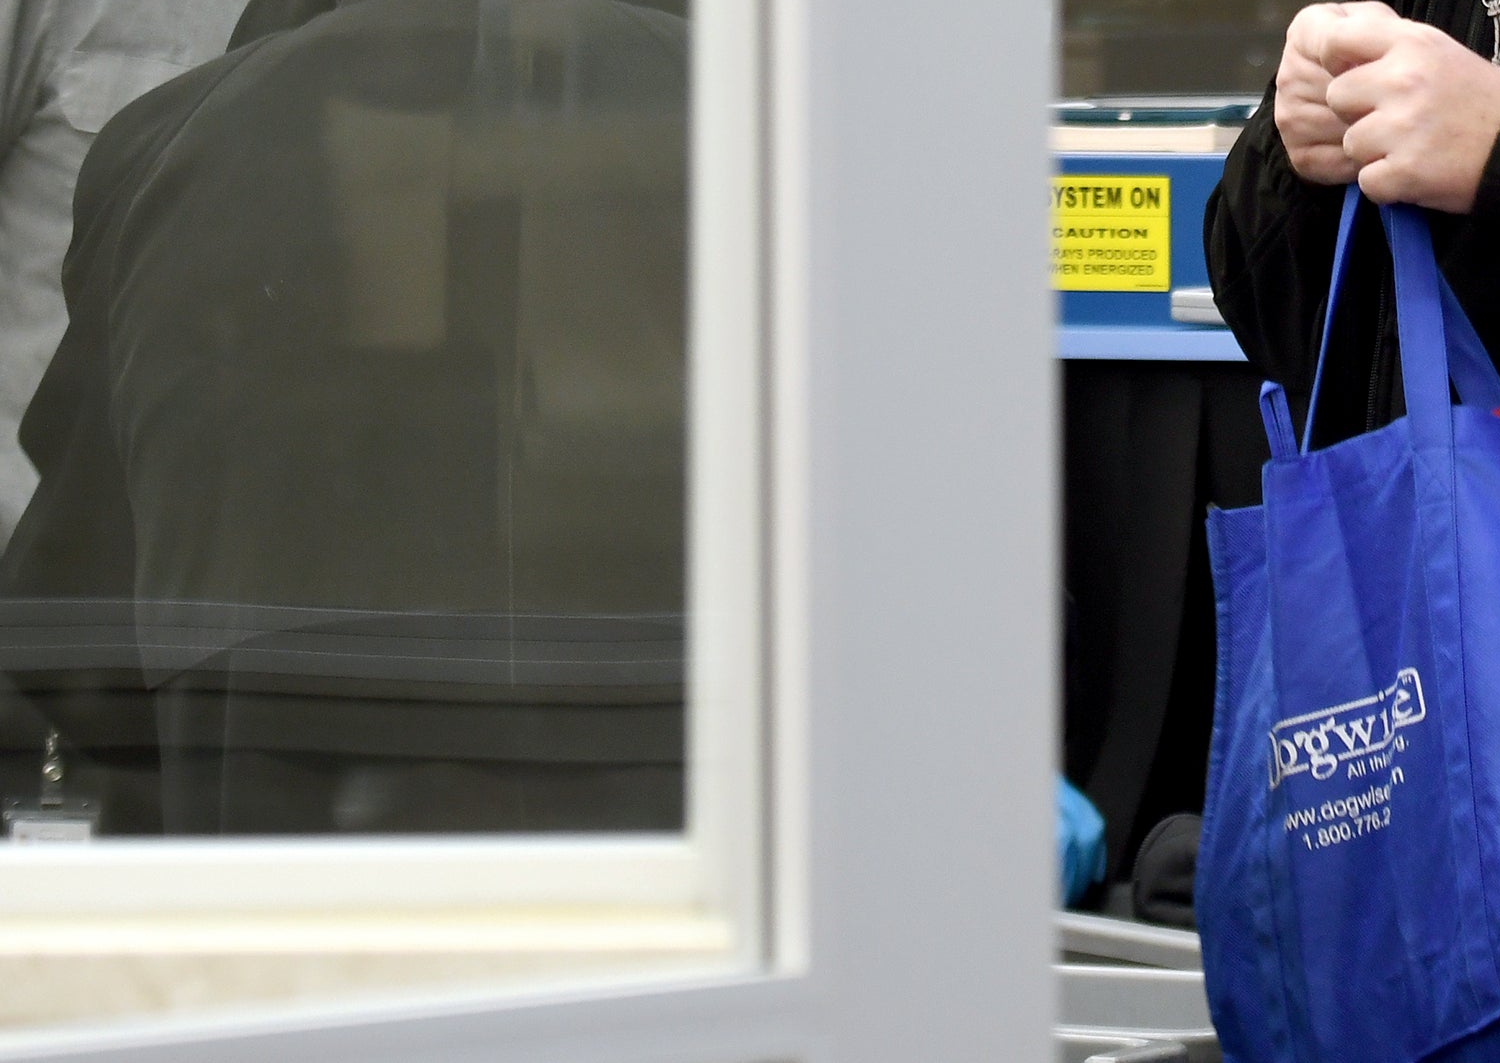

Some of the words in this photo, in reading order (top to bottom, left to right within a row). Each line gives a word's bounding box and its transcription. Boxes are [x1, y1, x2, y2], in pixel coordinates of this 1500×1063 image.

[1050, 185, 1123, 209] YSTEM
[1130, 186, 1161, 209] ON
[1053, 228, 1149, 239] CAUTION
[1087, 248, 1158, 261] PRODUCED
[1083, 263, 1155, 276] ENERGIZED
[1347, 758, 1367, 780] All
